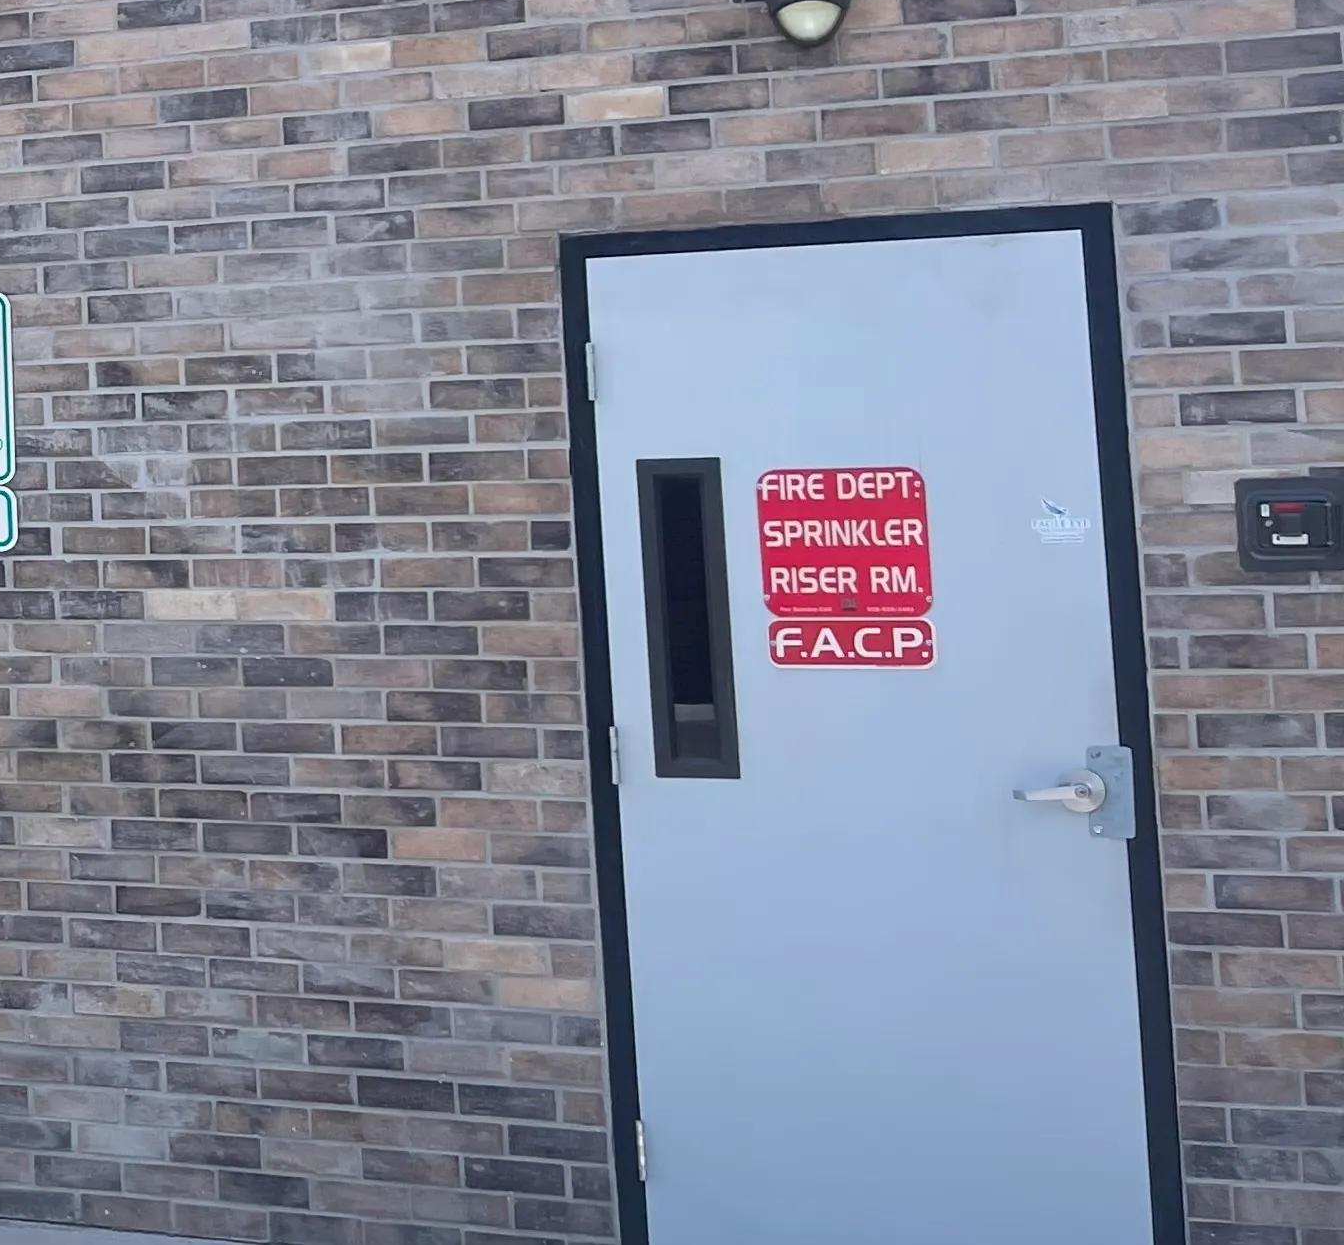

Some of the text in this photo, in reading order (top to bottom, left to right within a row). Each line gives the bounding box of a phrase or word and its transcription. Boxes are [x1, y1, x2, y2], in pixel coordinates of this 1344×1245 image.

[762, 473, 825, 501] FIRE
[762, 518, 925, 548] SPRINKLER
[769, 565, 924, 594] RISER RM.
[775, 627, 929, 658] F.A.C.P.
